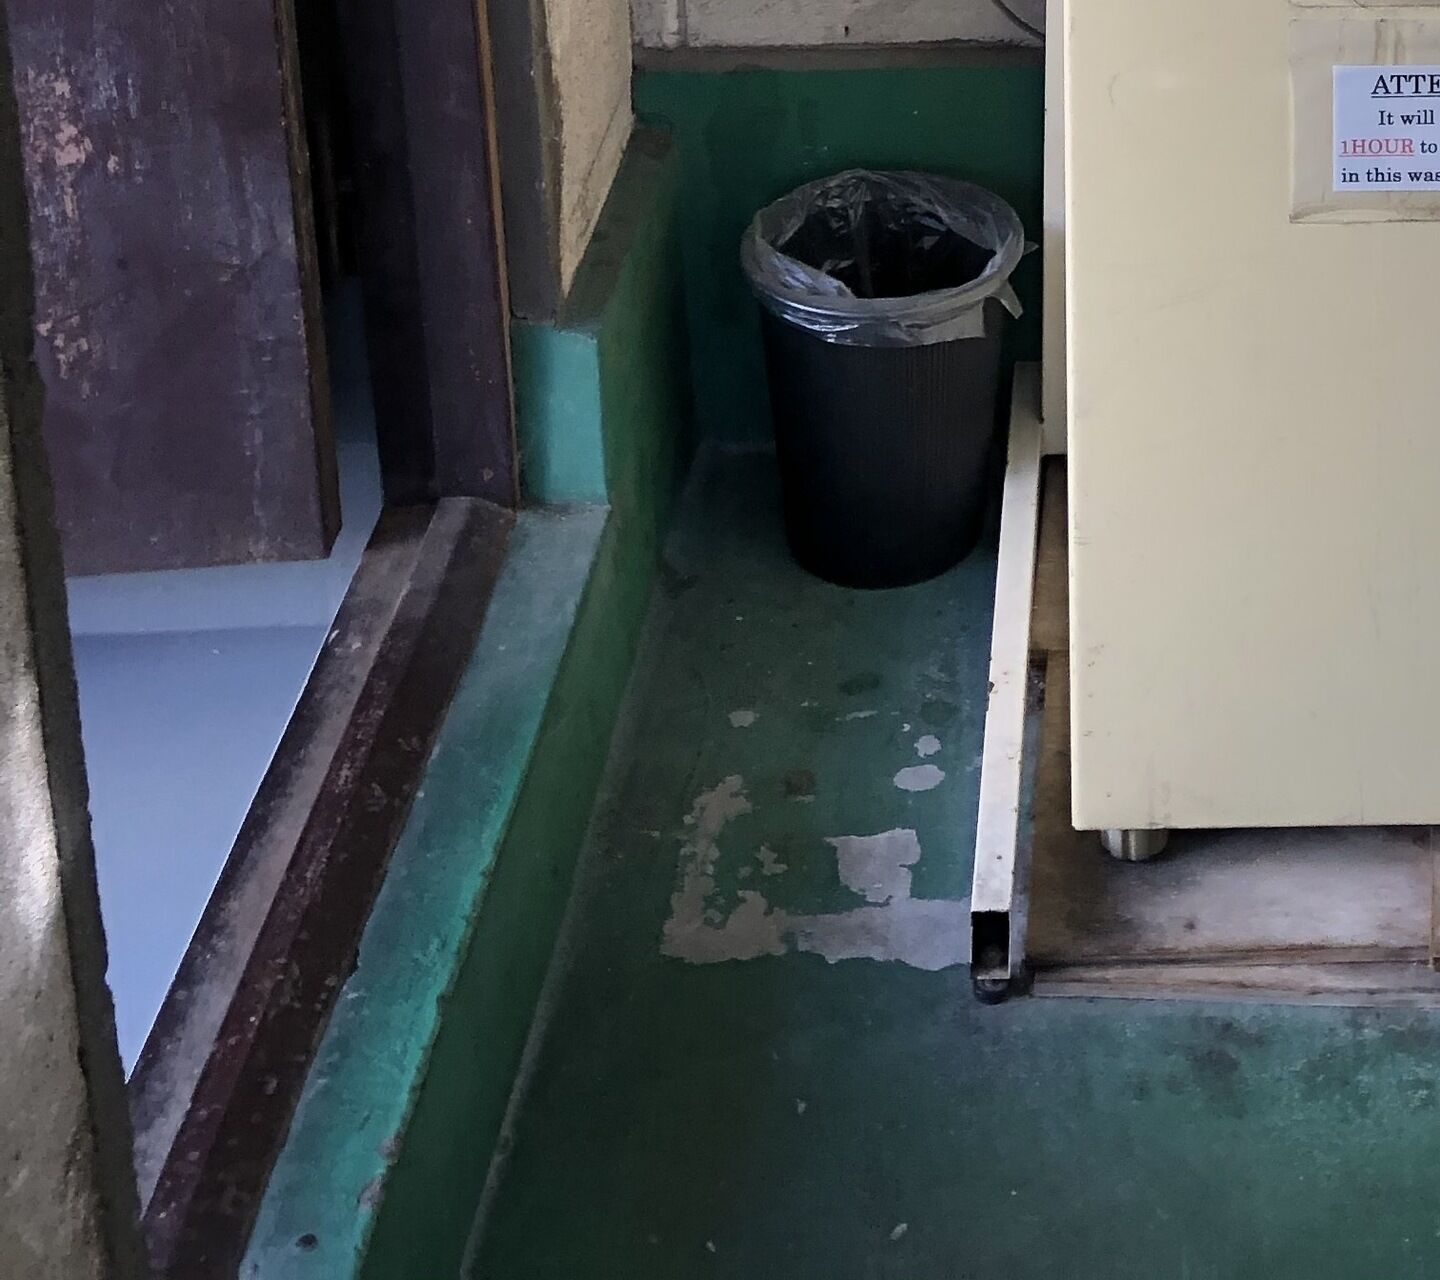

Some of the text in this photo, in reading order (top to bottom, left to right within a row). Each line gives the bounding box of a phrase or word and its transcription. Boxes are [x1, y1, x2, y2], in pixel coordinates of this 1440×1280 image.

[1378, 111, 1394, 126] It
[1400, 110, 1434, 125] will
[1339, 138, 1414, 156] 1HOUR
[1420, 139, 1438, 153] to
[1341, 168, 1359, 183] in
[1366, 167, 1401, 183] this
